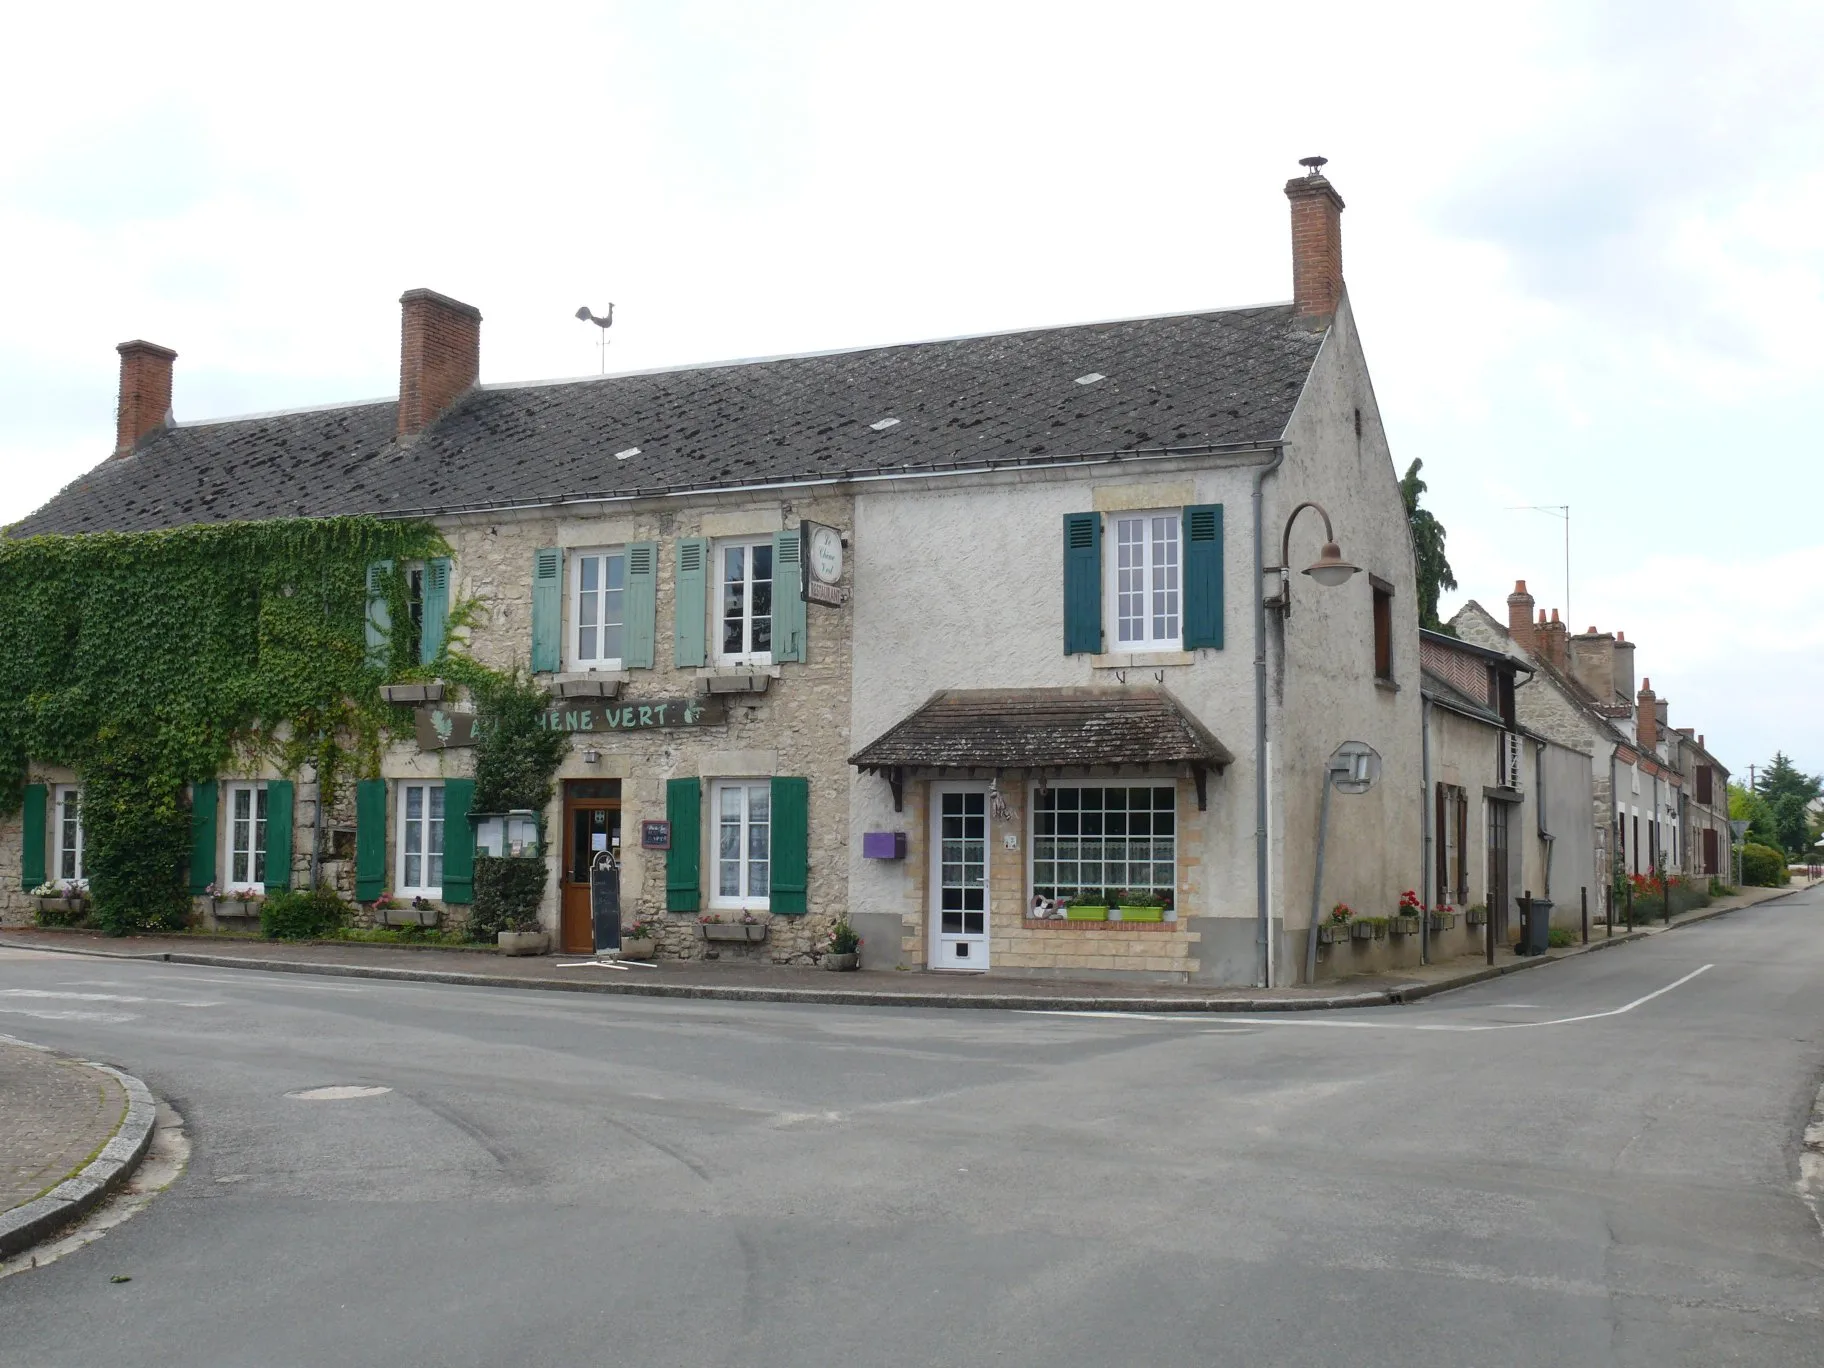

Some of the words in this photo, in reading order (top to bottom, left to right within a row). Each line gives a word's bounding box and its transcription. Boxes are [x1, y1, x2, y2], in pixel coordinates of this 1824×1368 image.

[811, 582, 840, 603] RESTAURANT
[534, 710, 593, 731] HENE
[606, 703, 668, 728] VERT
